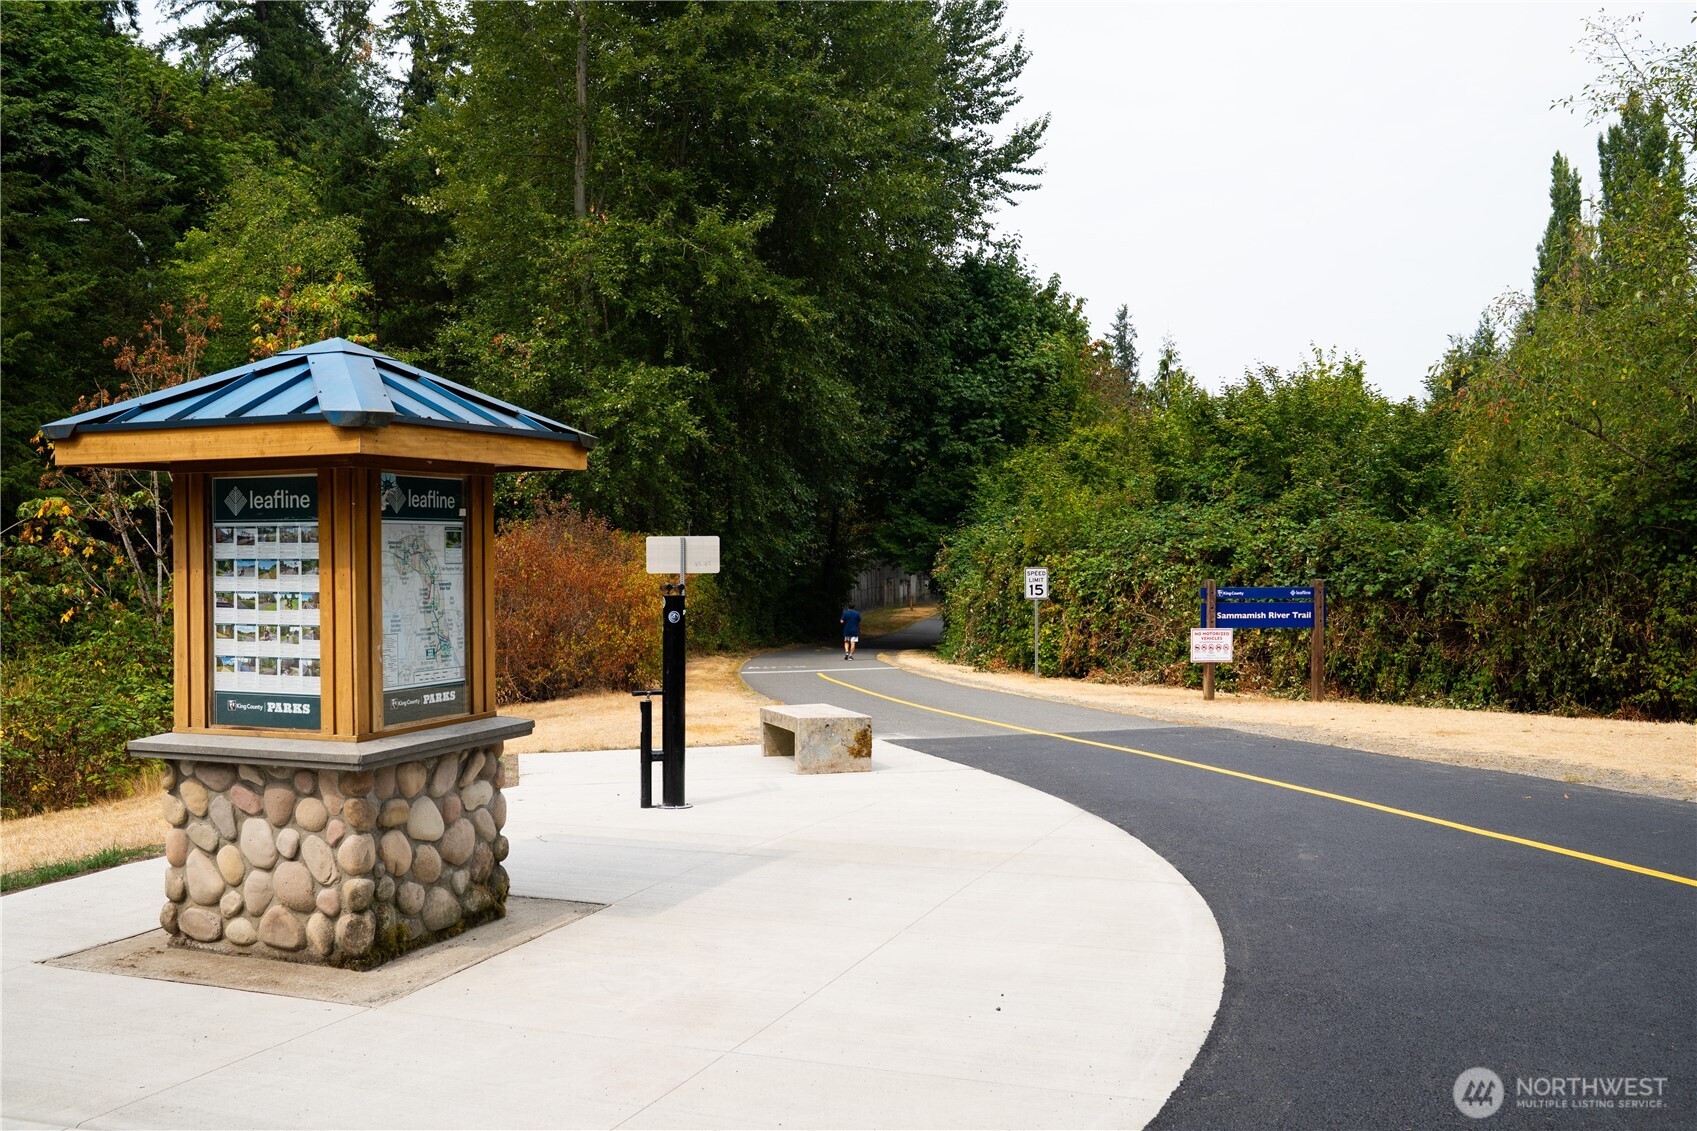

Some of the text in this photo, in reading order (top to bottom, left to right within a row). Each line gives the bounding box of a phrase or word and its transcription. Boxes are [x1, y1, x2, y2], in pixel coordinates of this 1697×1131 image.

[249, 489, 311, 509] leafline
[408, 488, 456, 509] leafline
[1029, 584, 1044, 596] 15
[1216, 611, 1312, 619] Sammamish River Trail
[423, 690, 456, 705] PARKS
[236, 702, 311, 714] King County PARKS
